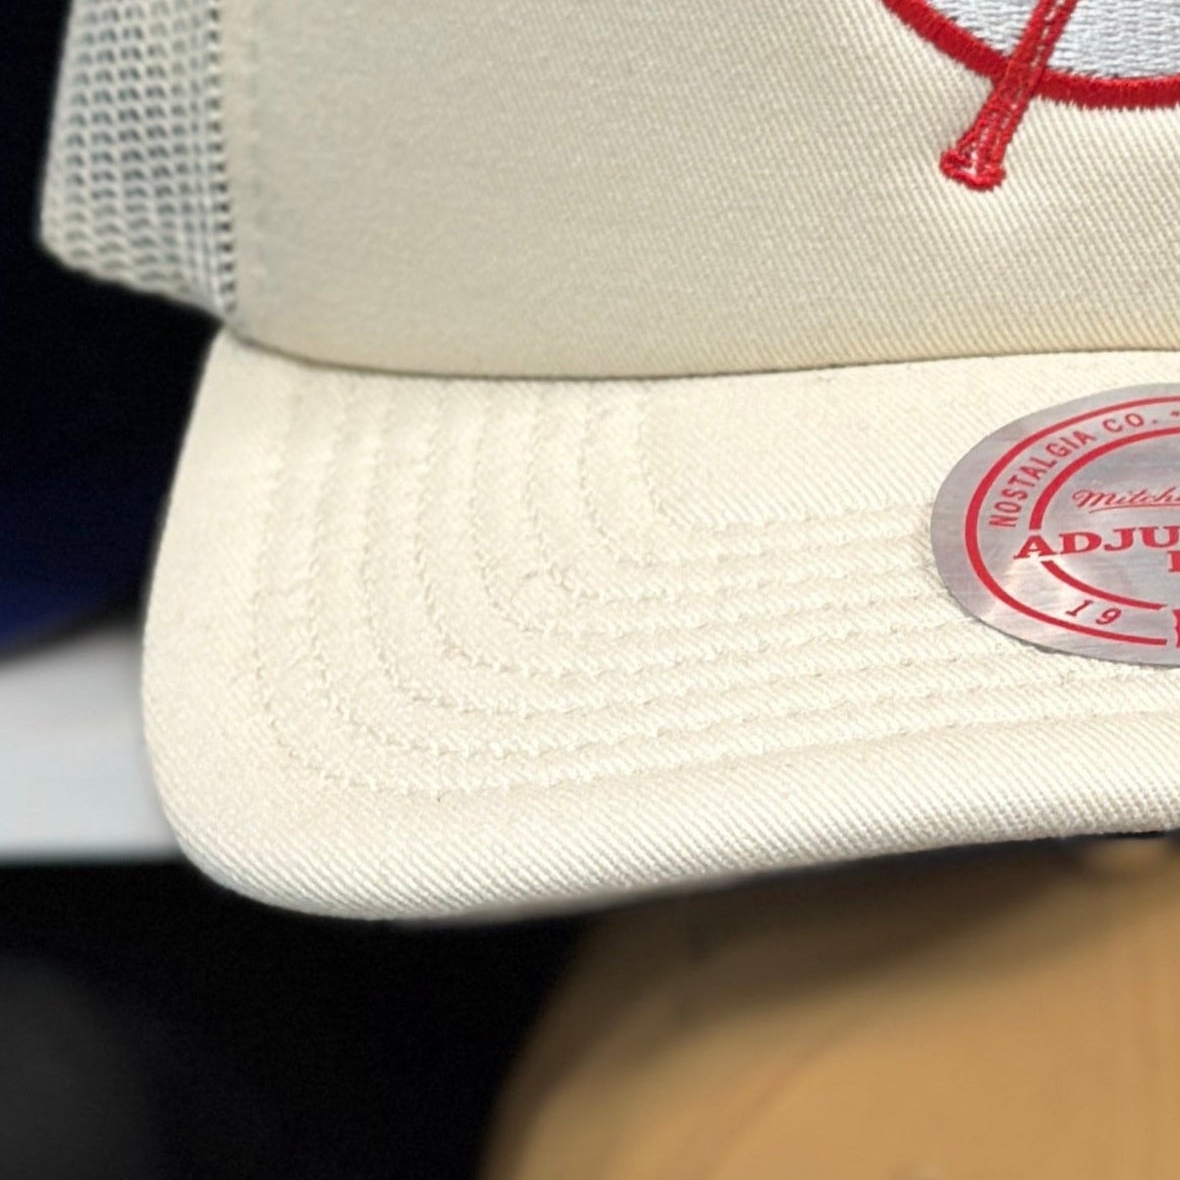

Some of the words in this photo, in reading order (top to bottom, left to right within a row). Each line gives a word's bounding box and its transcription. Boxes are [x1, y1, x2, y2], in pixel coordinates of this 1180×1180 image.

[990, 429, 1098, 529] NOSTALGIA
[1102, 410, 1159, 434] CO.
[1064, 598, 1123, 626] 19
